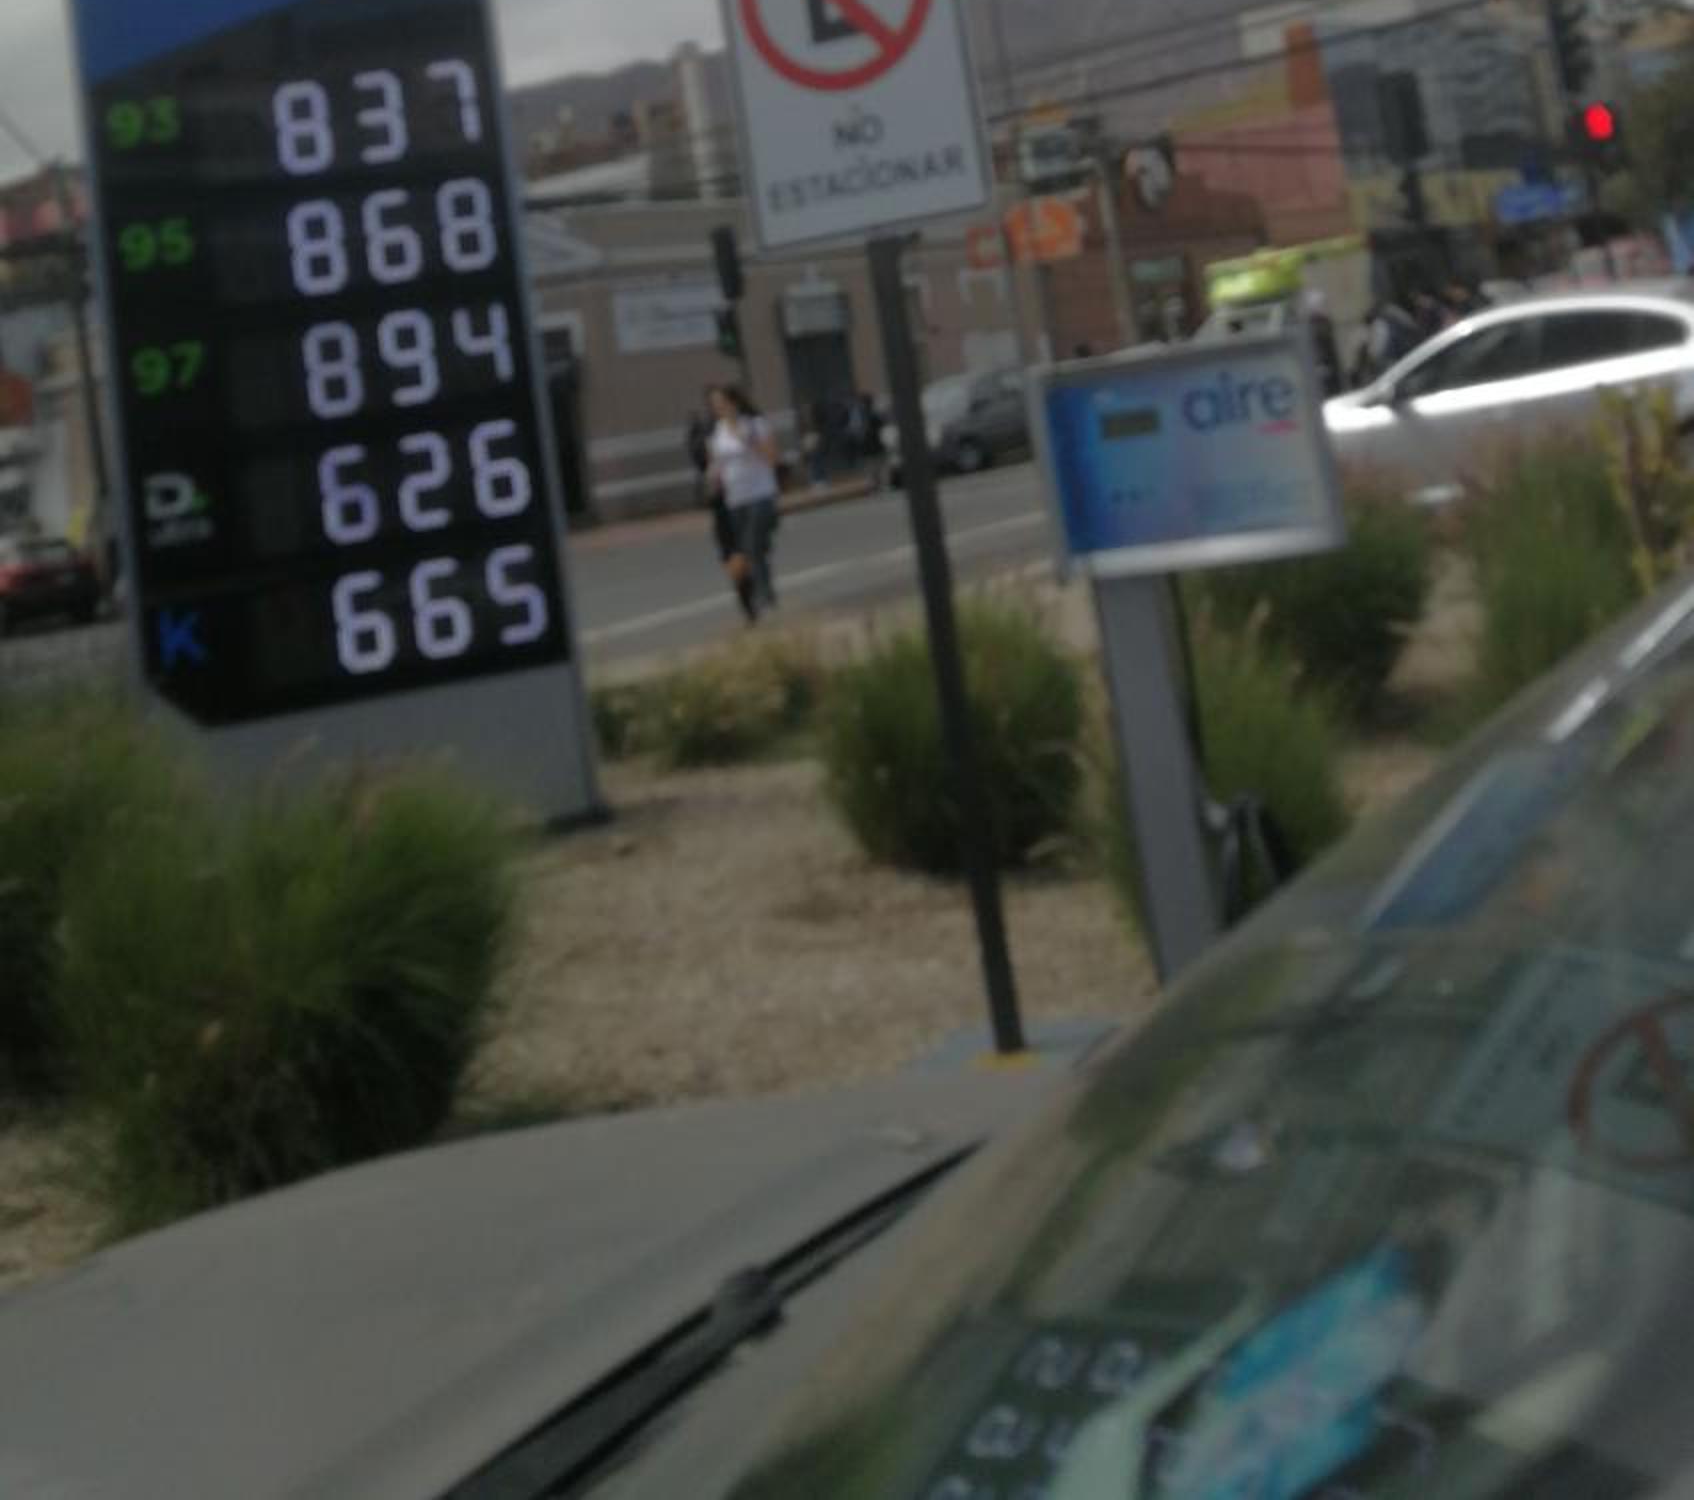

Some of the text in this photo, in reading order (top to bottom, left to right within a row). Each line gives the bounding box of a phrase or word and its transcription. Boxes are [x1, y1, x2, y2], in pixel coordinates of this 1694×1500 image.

[107, 98, 180, 148] 93
[272, 58, 481, 176] 837
[831, 114, 885, 149] NO
[767, 145, 965, 212] ESTACIONAR
[119, 217, 194, 271] 95
[286, 177, 498, 296] 868
[131, 342, 204, 395] 97
[302, 304, 514, 419] 894
[1182, 371, 1295, 436] aire
[317, 418, 533, 546] 626
[158, 609, 207, 668] K
[332, 543, 549, 674] 665
